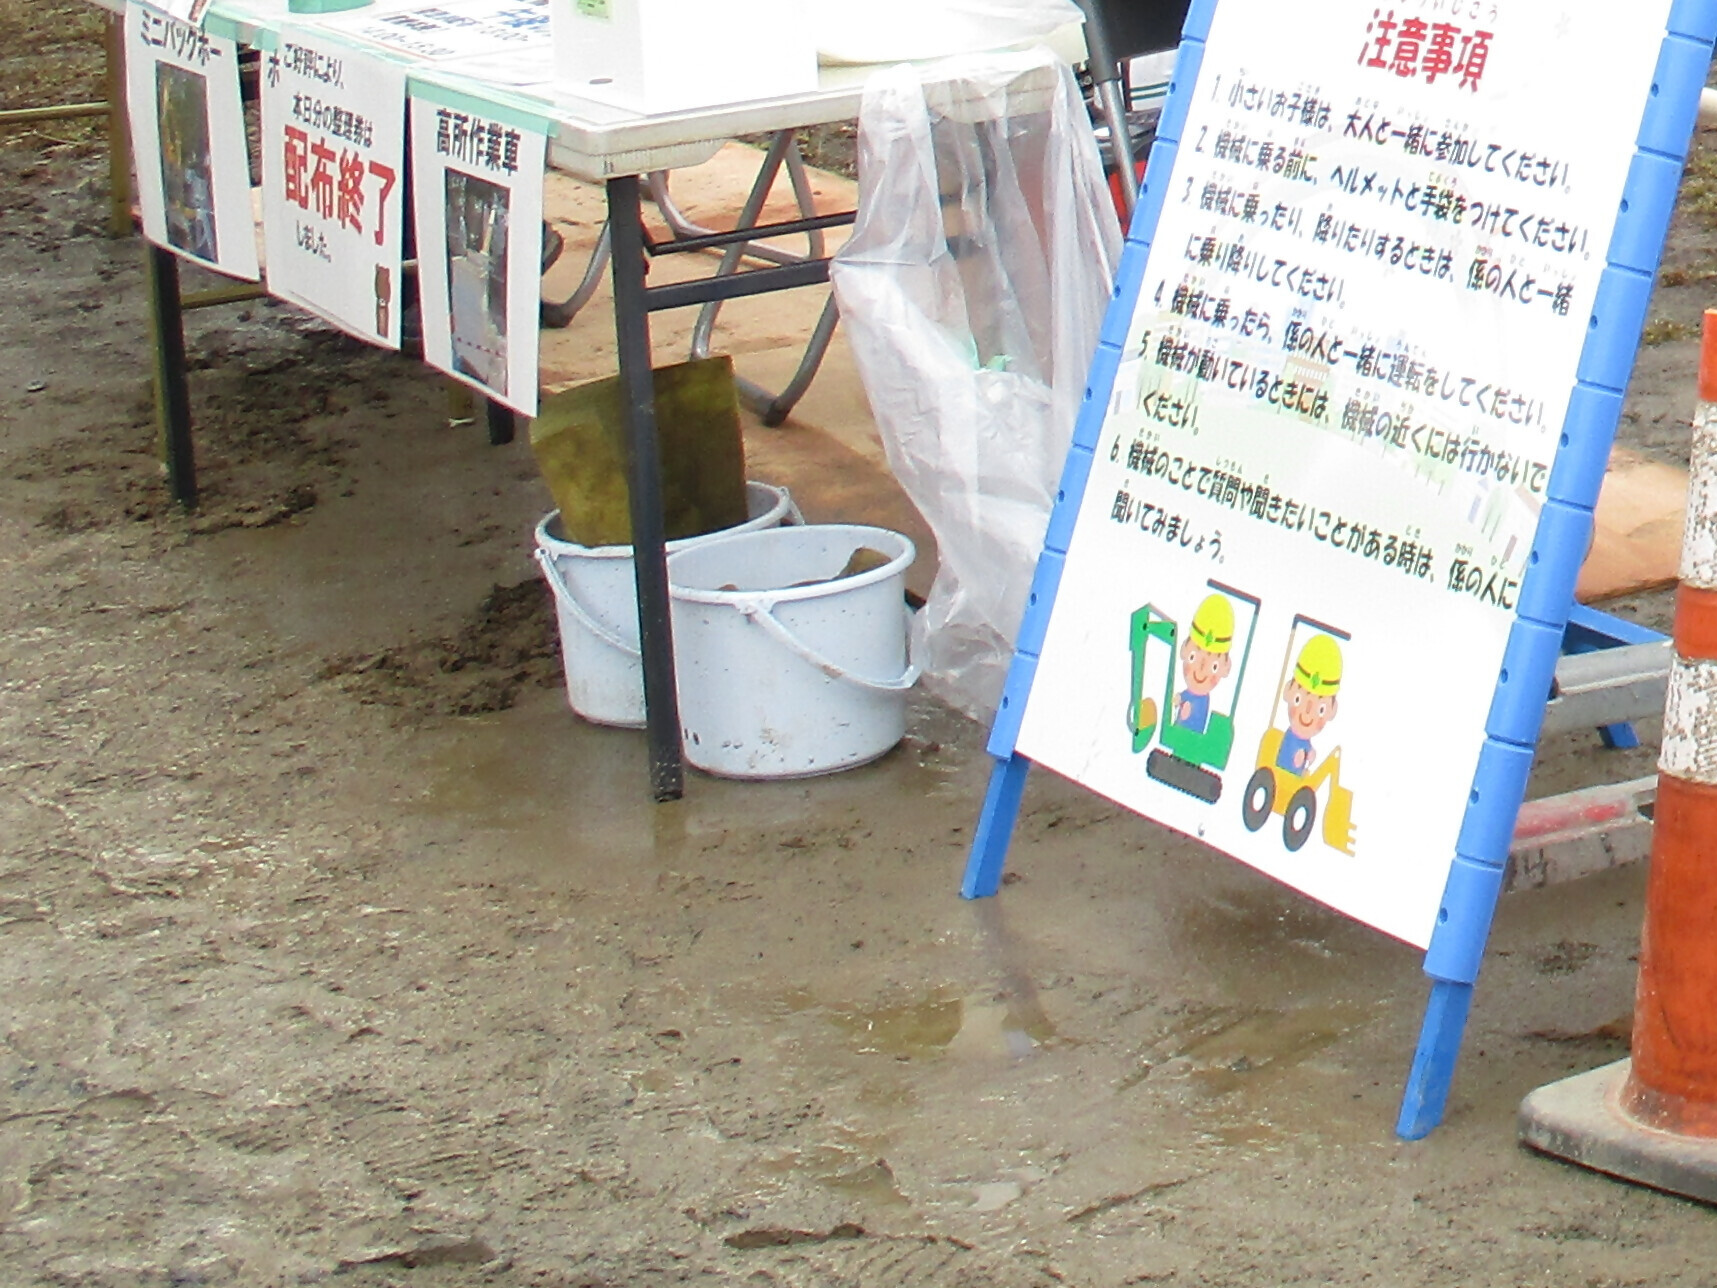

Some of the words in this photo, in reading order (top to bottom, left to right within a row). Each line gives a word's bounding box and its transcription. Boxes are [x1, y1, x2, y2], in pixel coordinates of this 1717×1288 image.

[1357, 8, 1494, 93] 注意事項
[436, 107, 521, 176] 高所作業車
[285, 124, 396, 246] 配布終了
[1141, 391, 1199, 437] ください。
[1110, 488, 1227, 565] 聞いてみましょう。
